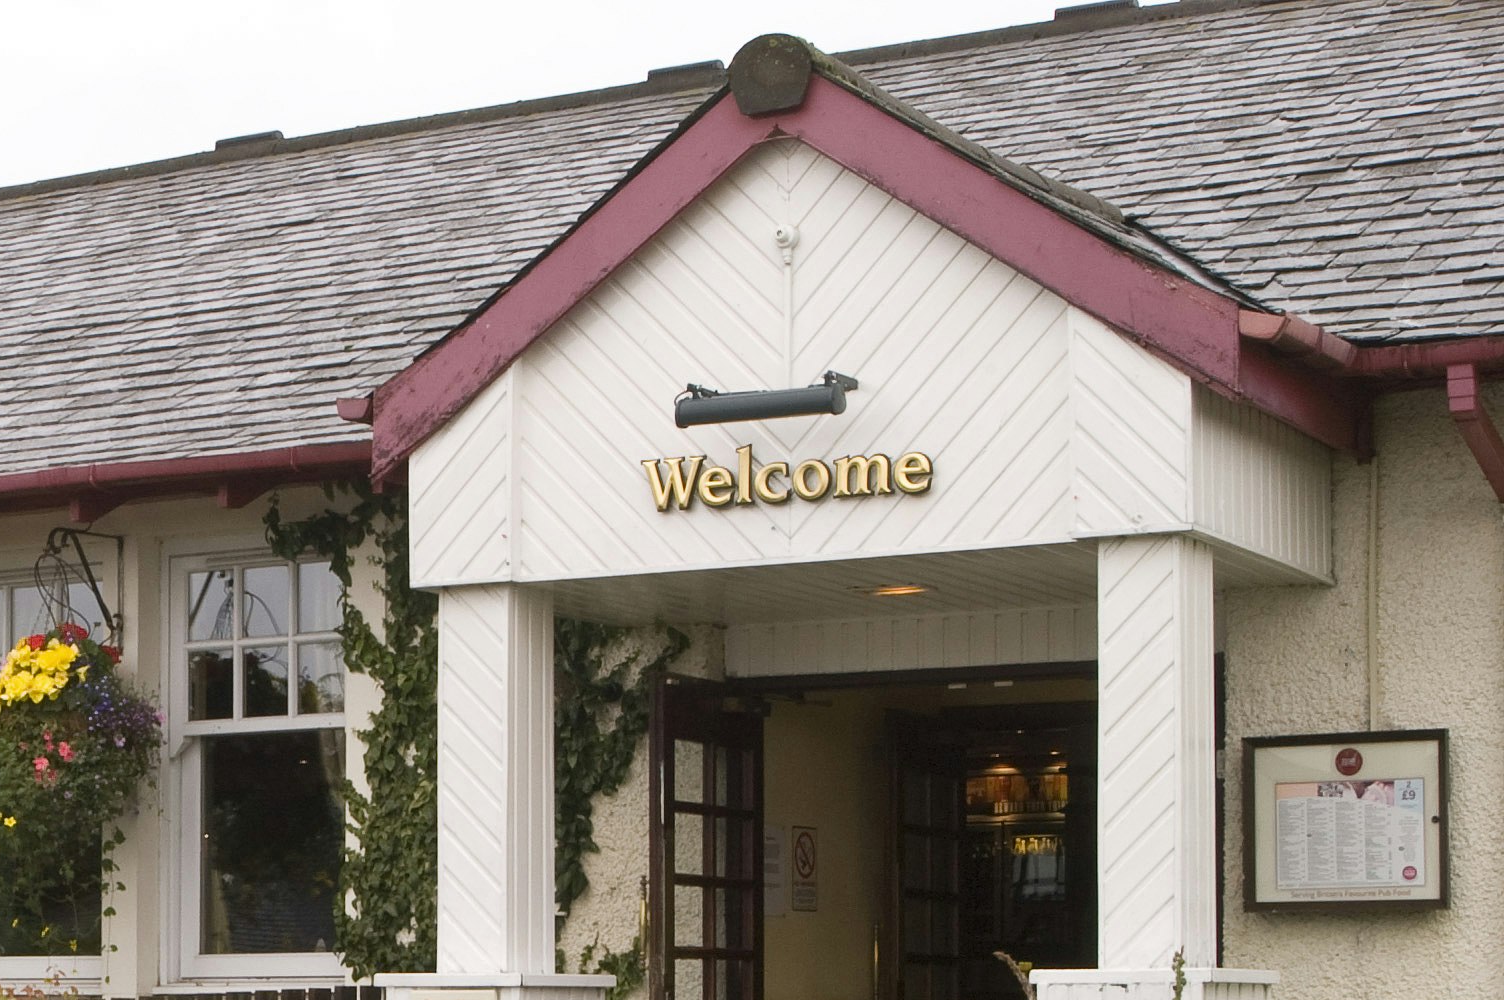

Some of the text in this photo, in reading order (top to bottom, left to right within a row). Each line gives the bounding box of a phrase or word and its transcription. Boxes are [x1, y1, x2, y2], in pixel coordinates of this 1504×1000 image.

[641, 443, 934, 512] Welcome
[1402, 789, 1416, 801] £9
[1378, 886, 1392, 897] Pub
